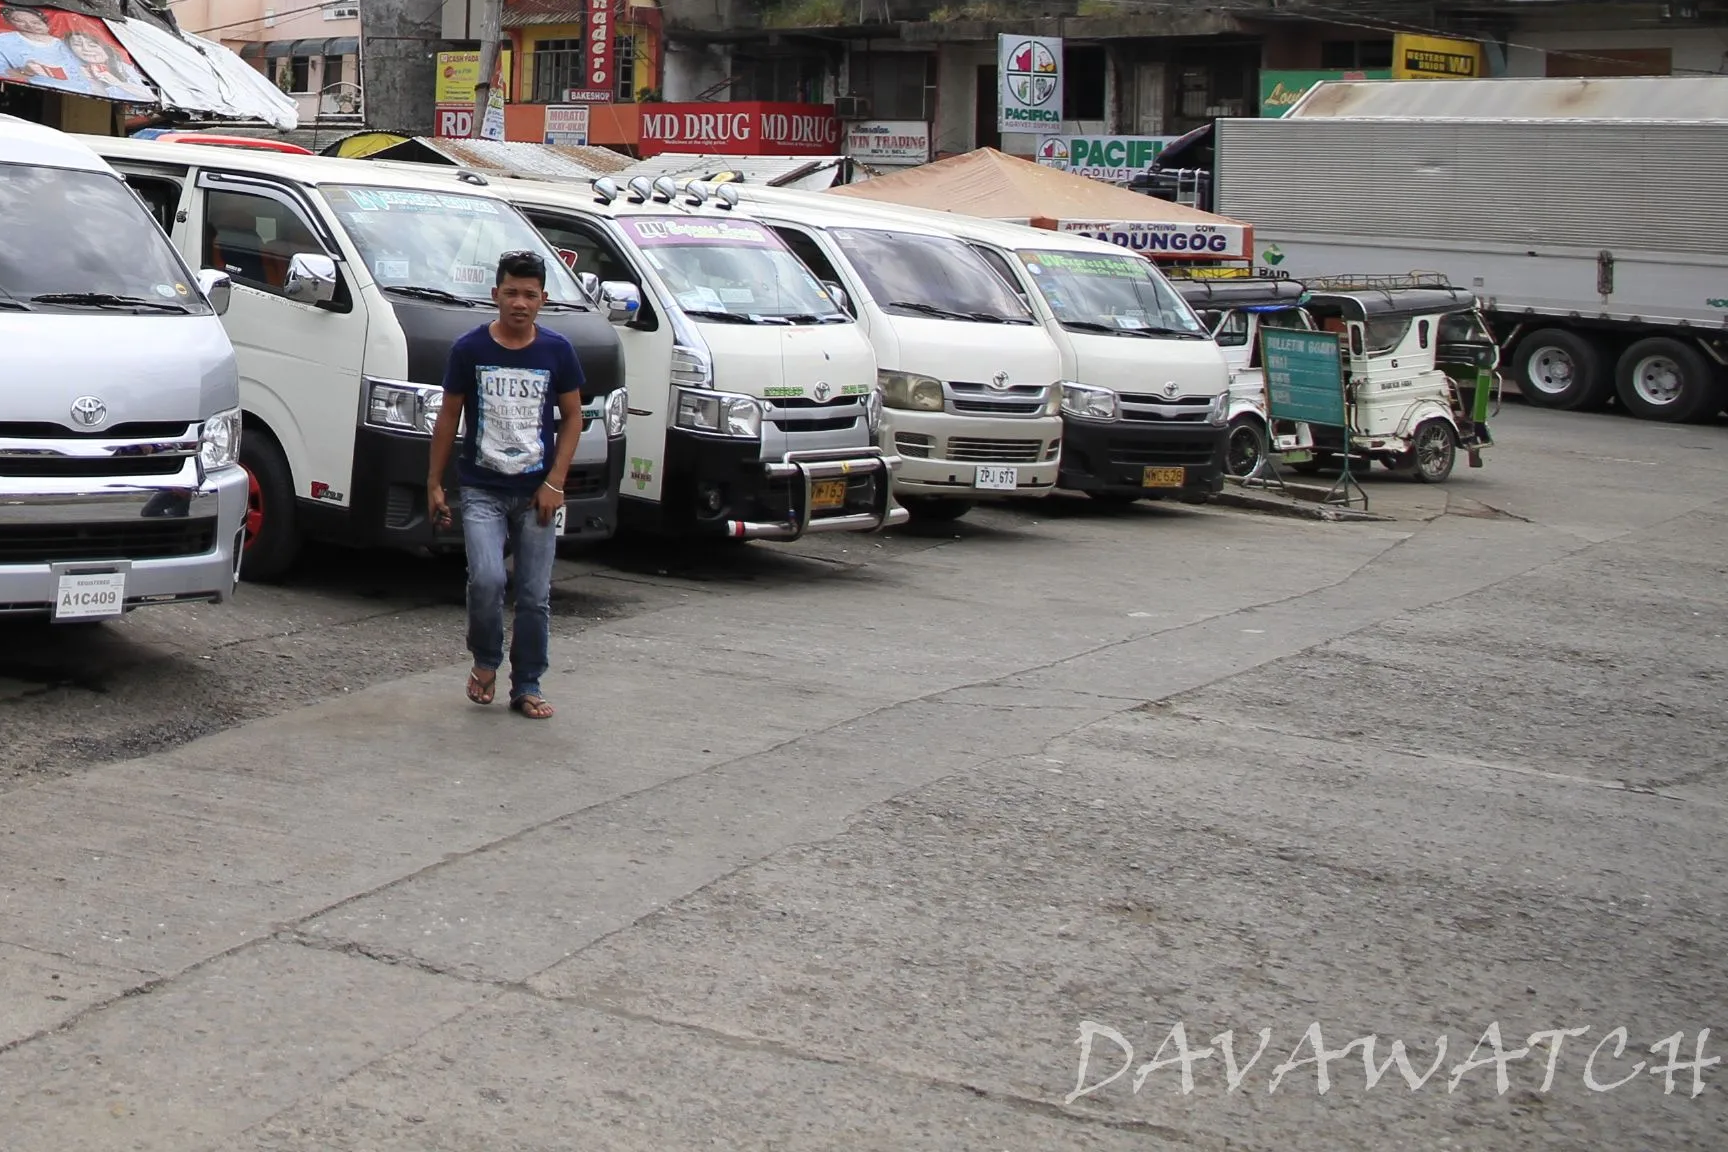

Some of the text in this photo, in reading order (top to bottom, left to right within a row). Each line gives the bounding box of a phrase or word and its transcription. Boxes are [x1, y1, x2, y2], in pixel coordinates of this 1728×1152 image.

[1419, 61, 1445, 70] UNION
[571, 91, 610, 101] BAKESHOP
[1005, 107, 1060, 122] PACIFICA
[441, 112, 472, 137] RD
[643, 113, 750, 141] MD DRUG
[761, 114, 836, 143] MD DRUG
[848, 136, 926, 148] WIN TRADING
[1195, 224, 1217, 233] COW
[454, 266, 485, 284] DAVAO
[1267, 336, 1305, 352] BULLETIN
[980, 469, 1014, 484] ZPJ 673
[62, 591, 117, 606] A1C409
